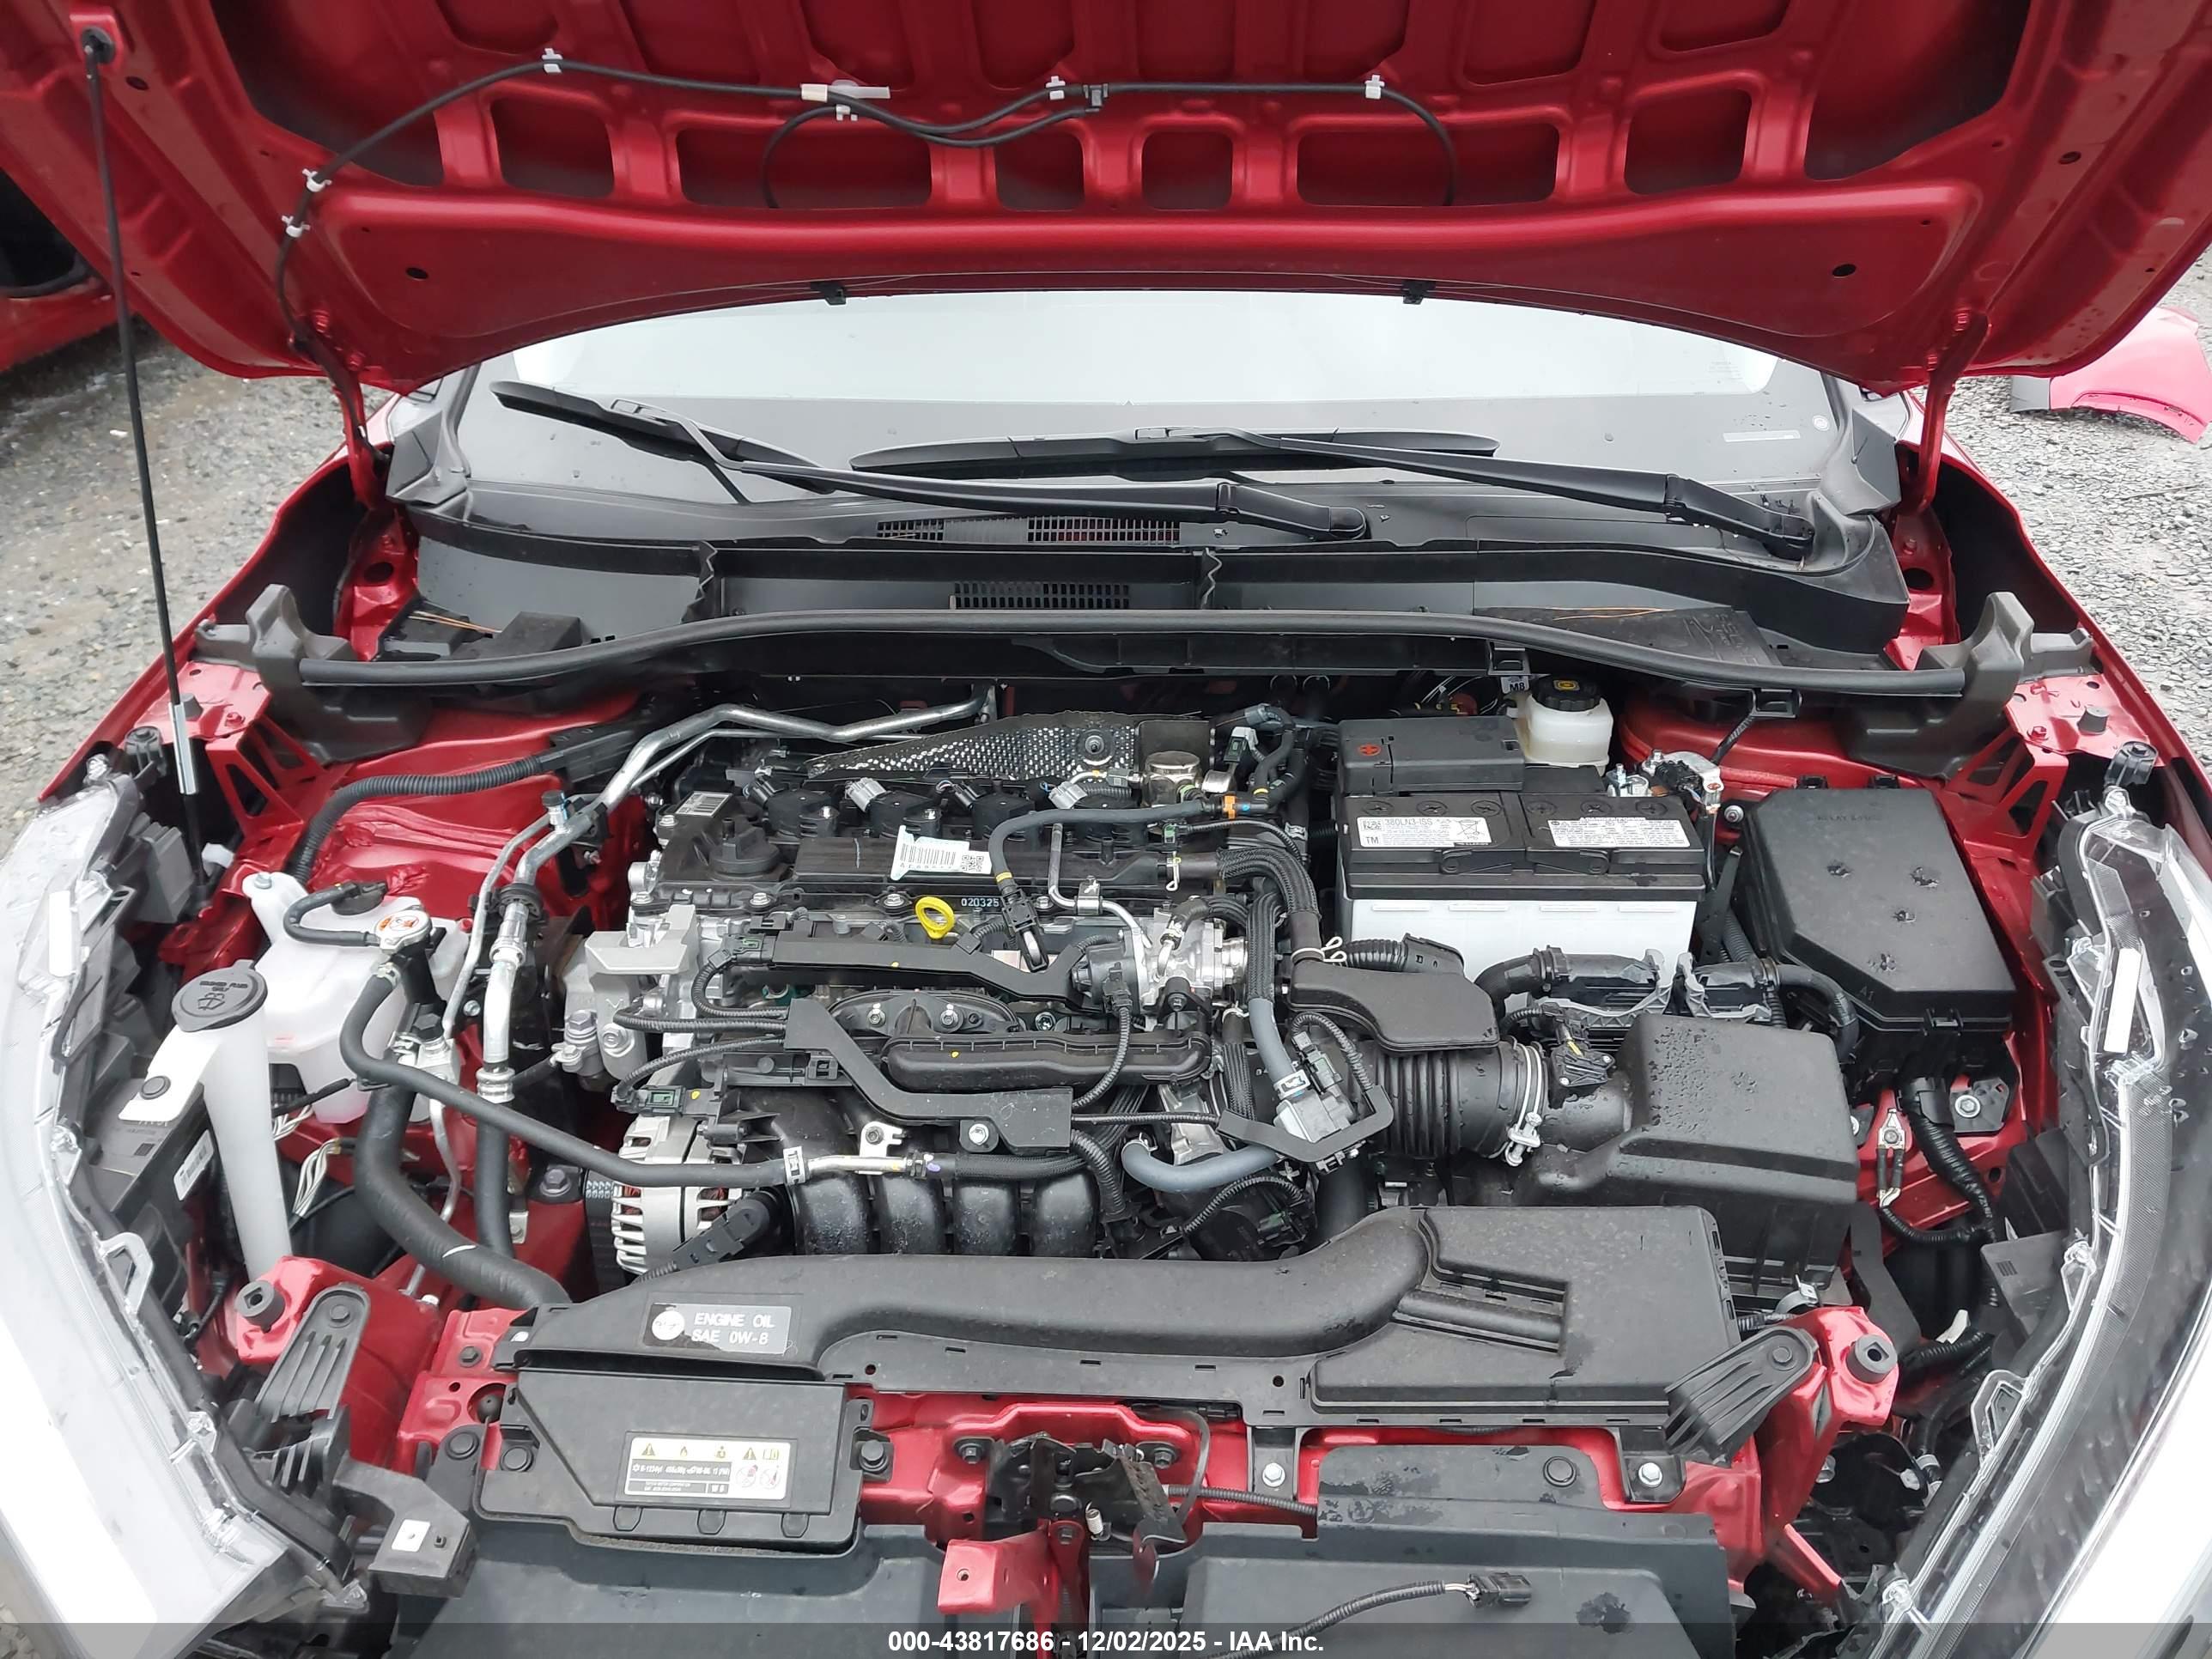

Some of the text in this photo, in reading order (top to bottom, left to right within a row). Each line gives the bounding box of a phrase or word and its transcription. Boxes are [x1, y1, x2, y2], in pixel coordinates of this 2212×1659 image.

[1510, 682, 1525, 691] M8
[1365, 836, 1379, 845] TM
[961, 898, 1000, 907] 020325
[694, 1312, 744, 1327] ENGINE
[753, 1315, 775, 1328] OIL
[691, 1329, 720, 1343] SAE
